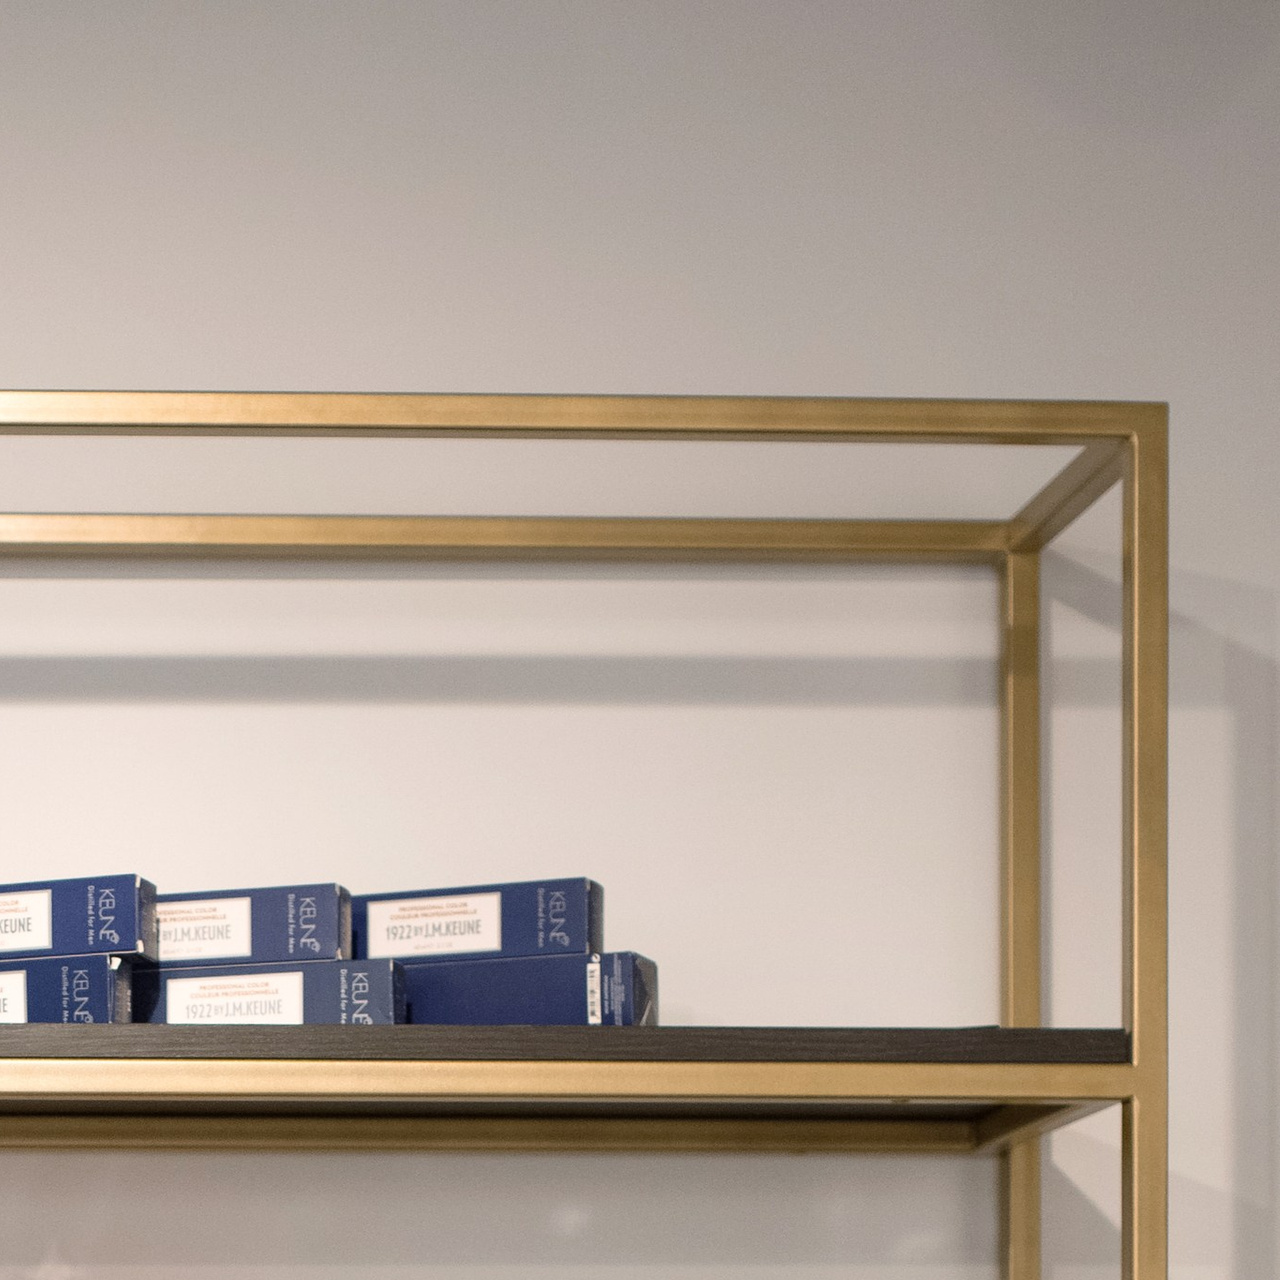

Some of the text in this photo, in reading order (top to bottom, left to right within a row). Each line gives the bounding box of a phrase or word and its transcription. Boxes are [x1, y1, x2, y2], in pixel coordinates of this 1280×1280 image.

[99, 888, 119, 944] KEUNE
[299, 897, 320, 952] KEUNE
[386, 925, 412, 941] 1922
[549, 891, 569, 946] KEUNE
[73, 969, 93, 1023] KEUNE
[352, 972, 373, 1024] KEUNE
